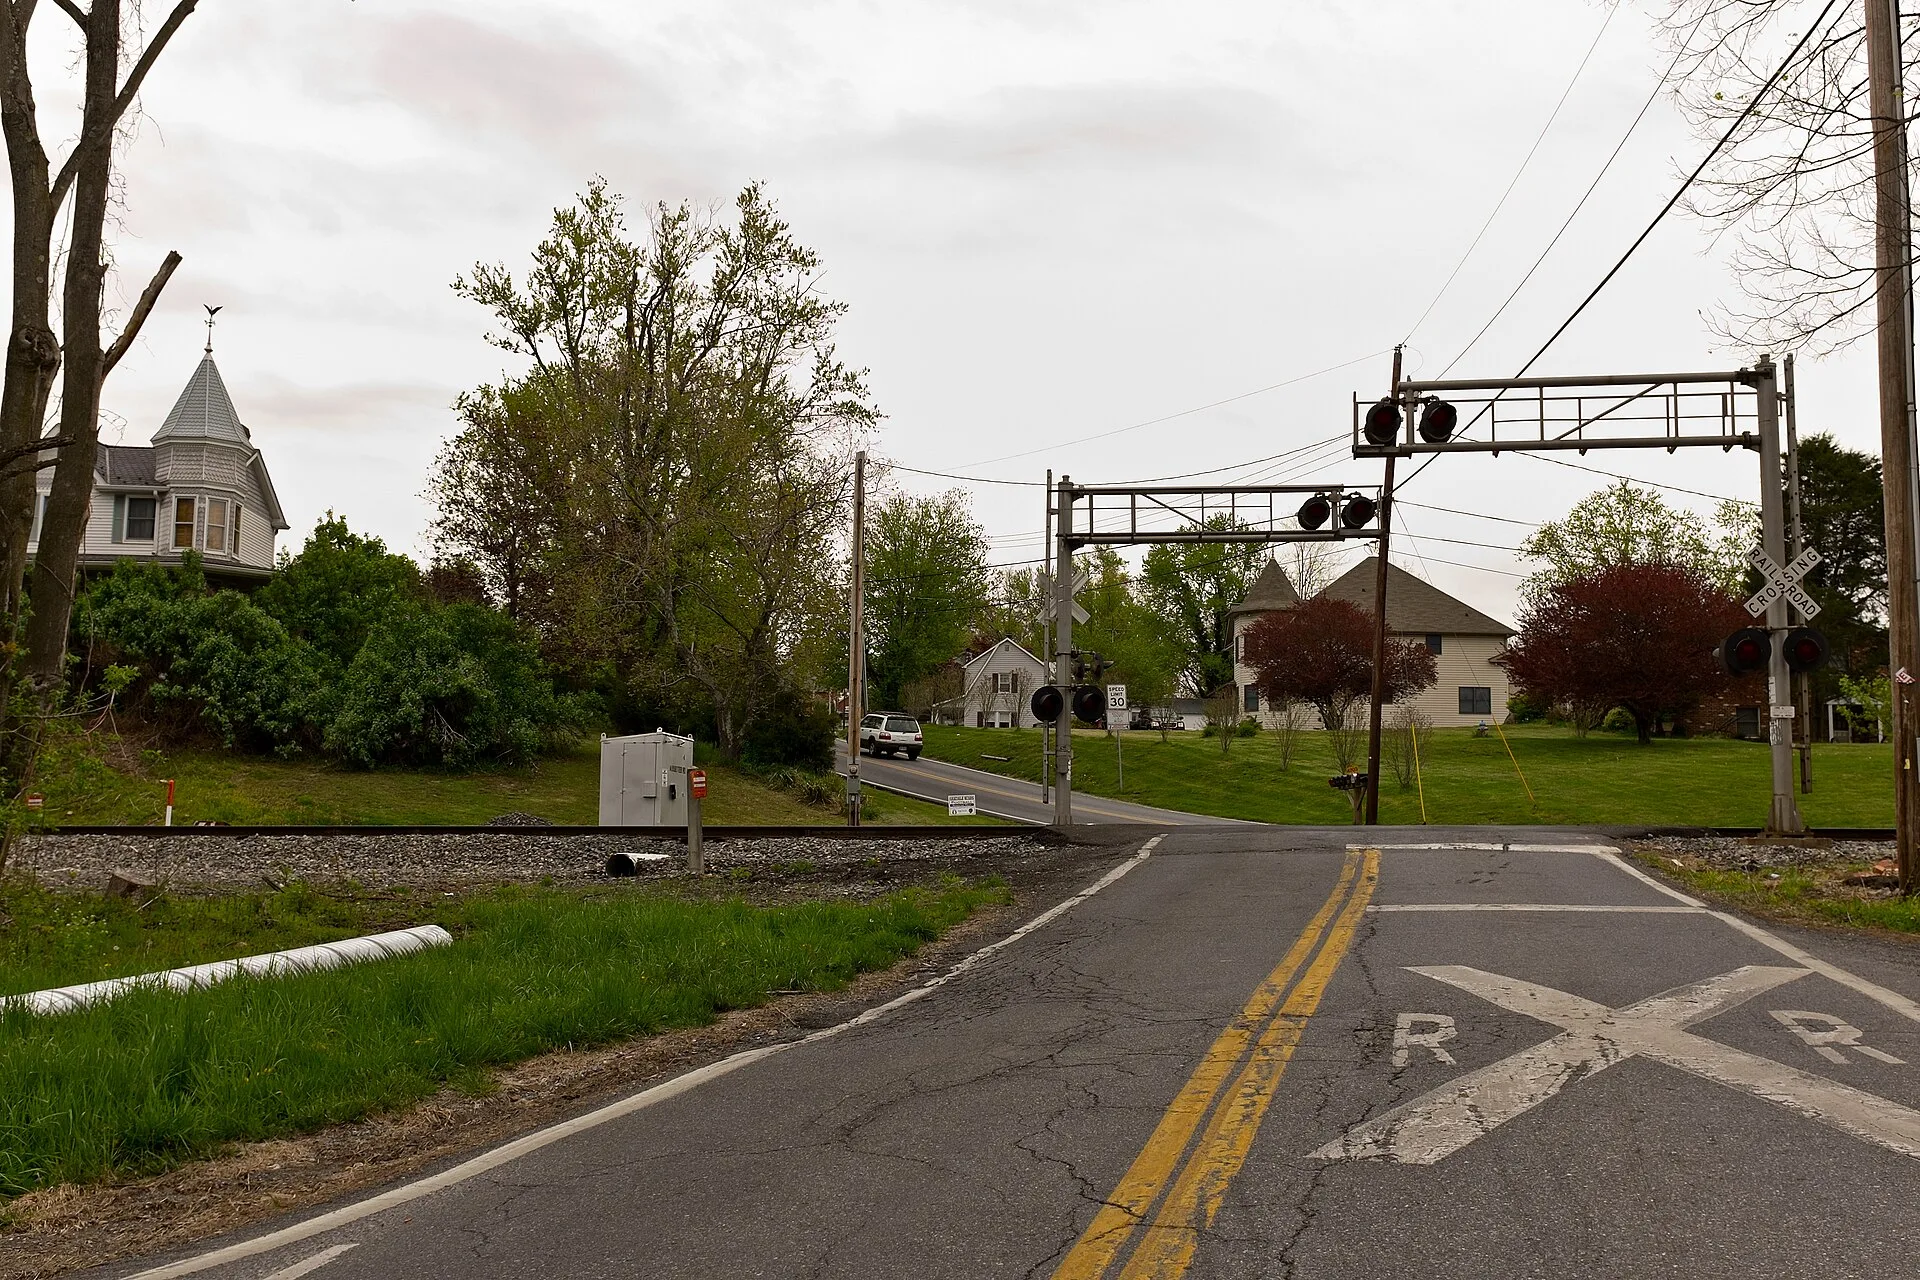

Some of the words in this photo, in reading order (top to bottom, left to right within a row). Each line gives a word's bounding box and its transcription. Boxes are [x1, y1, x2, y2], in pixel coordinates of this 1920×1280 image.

[1749, 551, 1818, 614] CROSSING
[1110, 697, 1125, 706] 30
[1391, 1011, 1459, 1068] R
[1766, 1010, 1907, 1065] R
